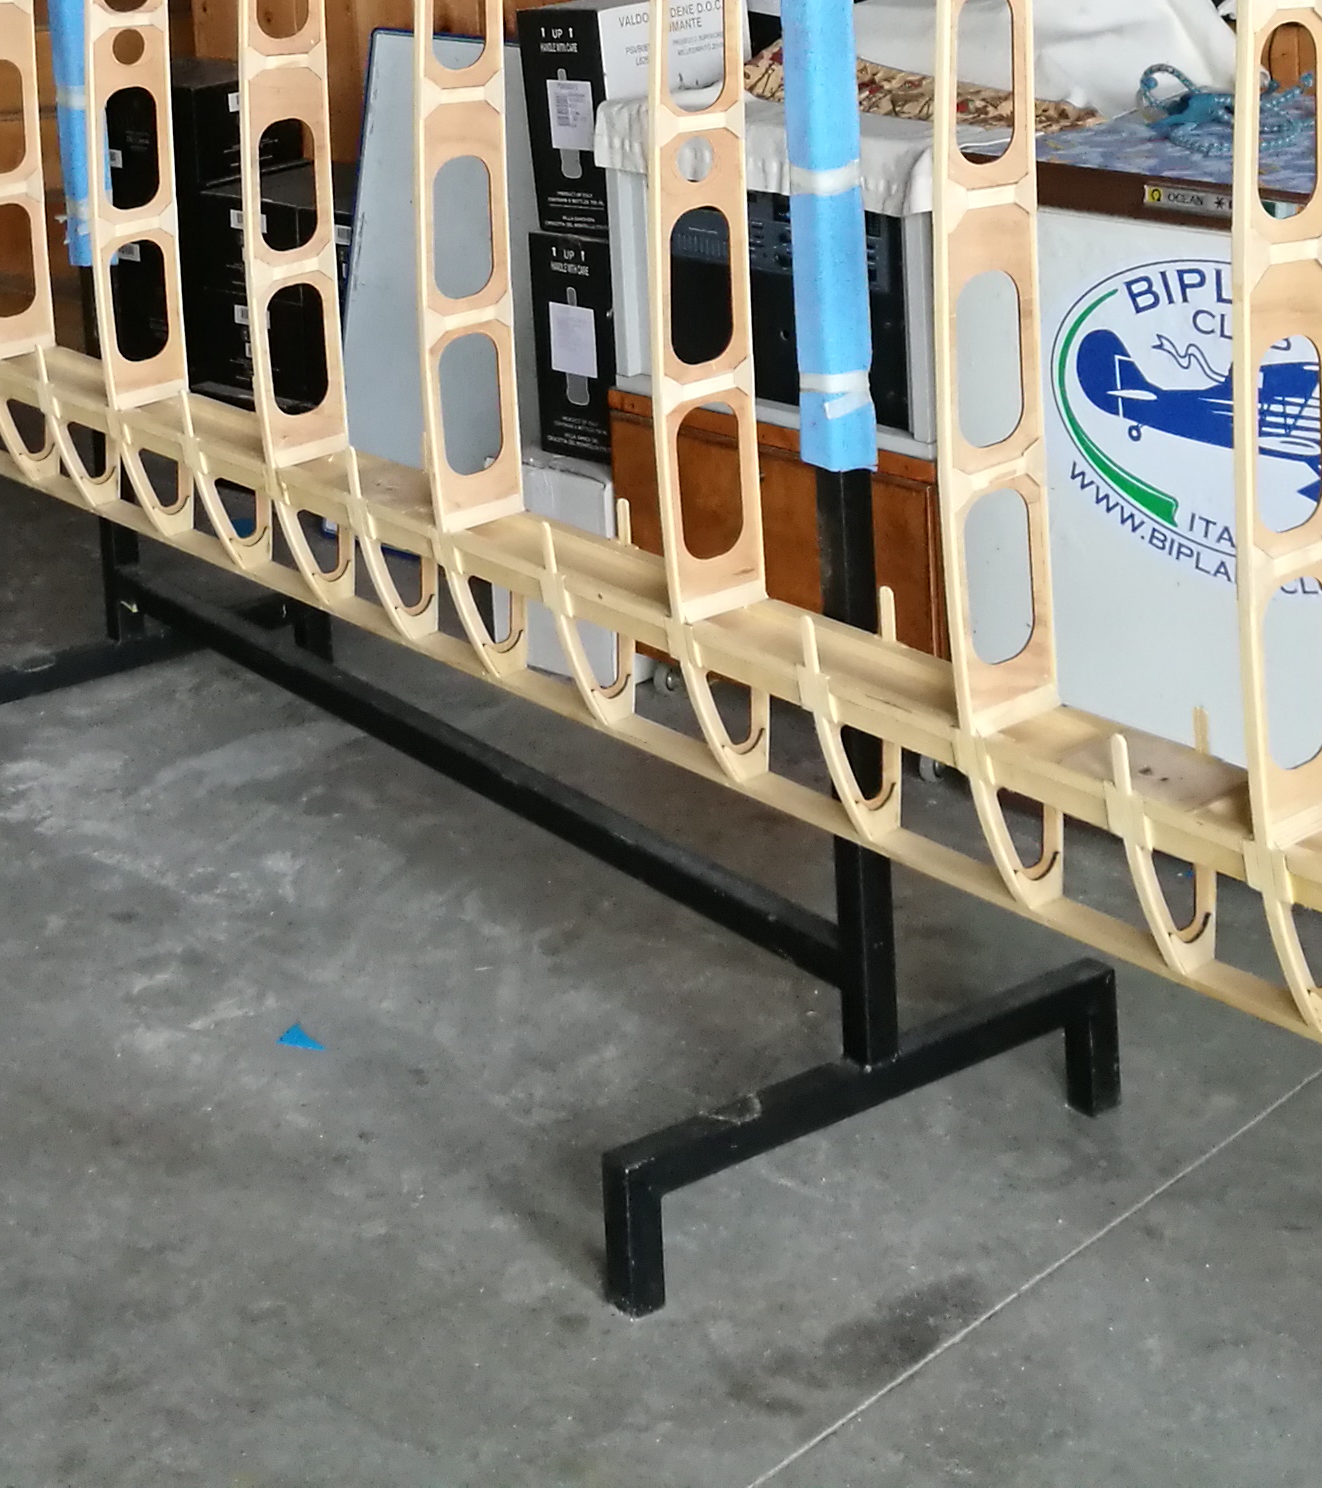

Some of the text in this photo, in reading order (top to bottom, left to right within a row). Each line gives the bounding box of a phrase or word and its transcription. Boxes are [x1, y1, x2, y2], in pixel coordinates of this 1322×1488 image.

[551, 28, 563, 39] UP
[1167, 193, 1204, 206] OCEAN
[563, 249, 575, 260] UP
